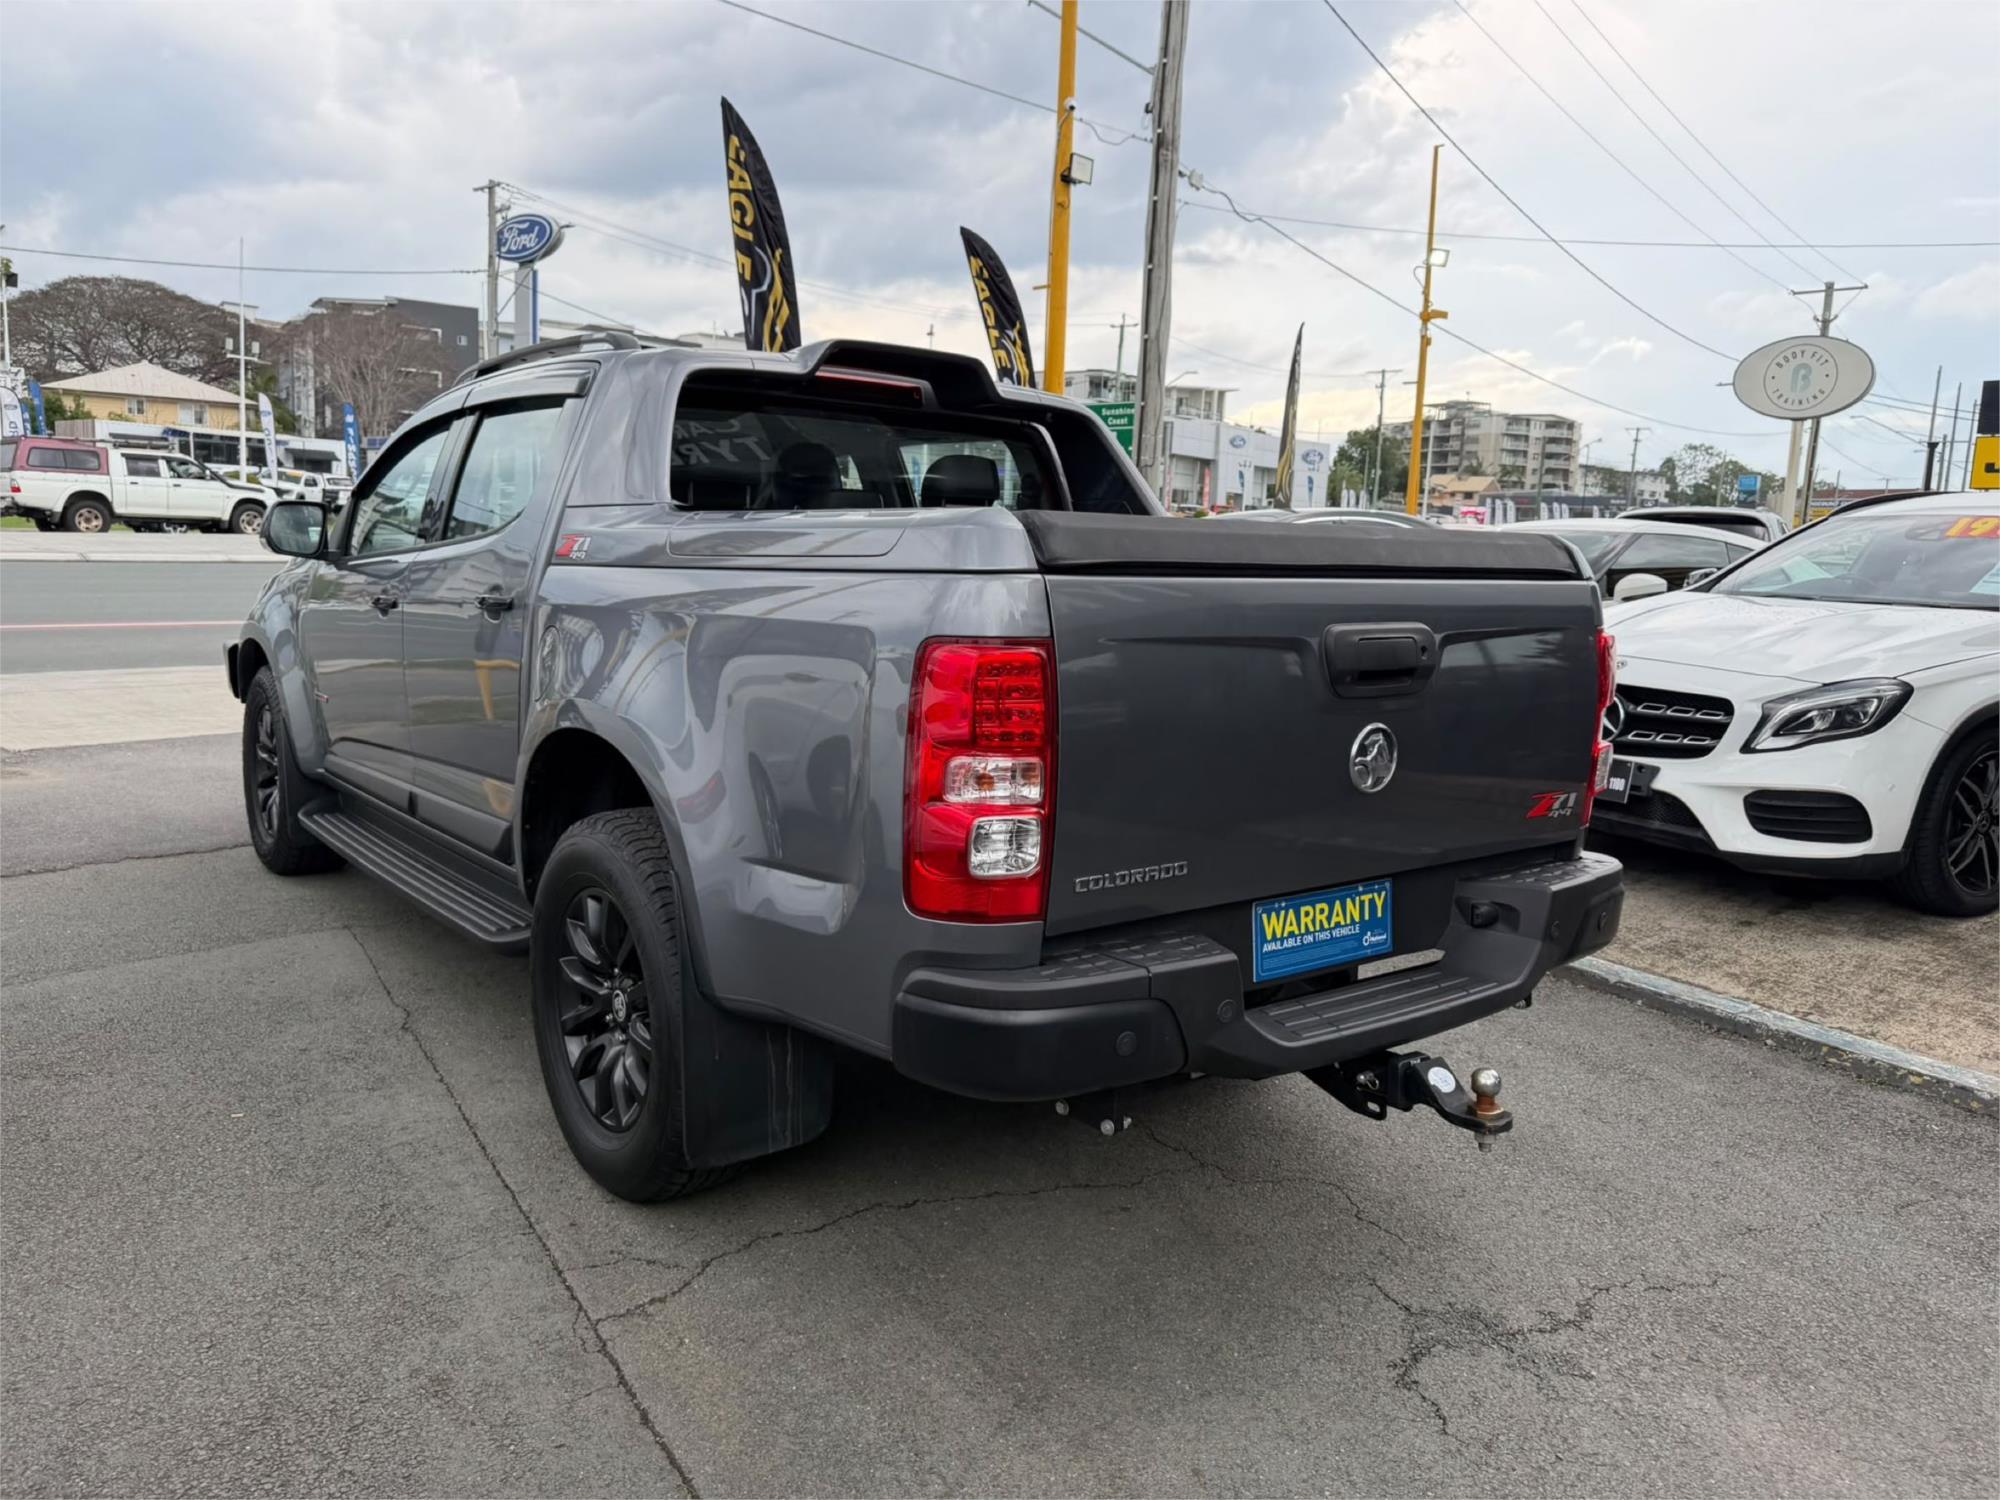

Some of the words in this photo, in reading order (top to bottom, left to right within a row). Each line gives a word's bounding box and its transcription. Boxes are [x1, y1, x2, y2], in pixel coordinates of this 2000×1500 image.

[728, 133, 755, 282] EAGLE
[500, 221, 540, 253] Ford
[970, 255, 1012, 370] EAGLE
[1775, 350, 1806, 369] BODY
[1810, 351, 1829, 366] FIT
[1107, 416, 1128, 425] Coast
[1945, 516, 2000, 538] 19
[555, 533, 592, 557] Z71
[1526, 791, 1578, 819] Z71
[1075, 861, 1188, 892] COLORADO
[1262, 891, 1386, 940] WARRANTY
[1262, 936, 1302, 953] AVAILABLE
[1303, 933, 1314, 944] ON
[1315, 929, 1331, 942] THIS
[1332, 924, 1360, 938] VEHICLE
